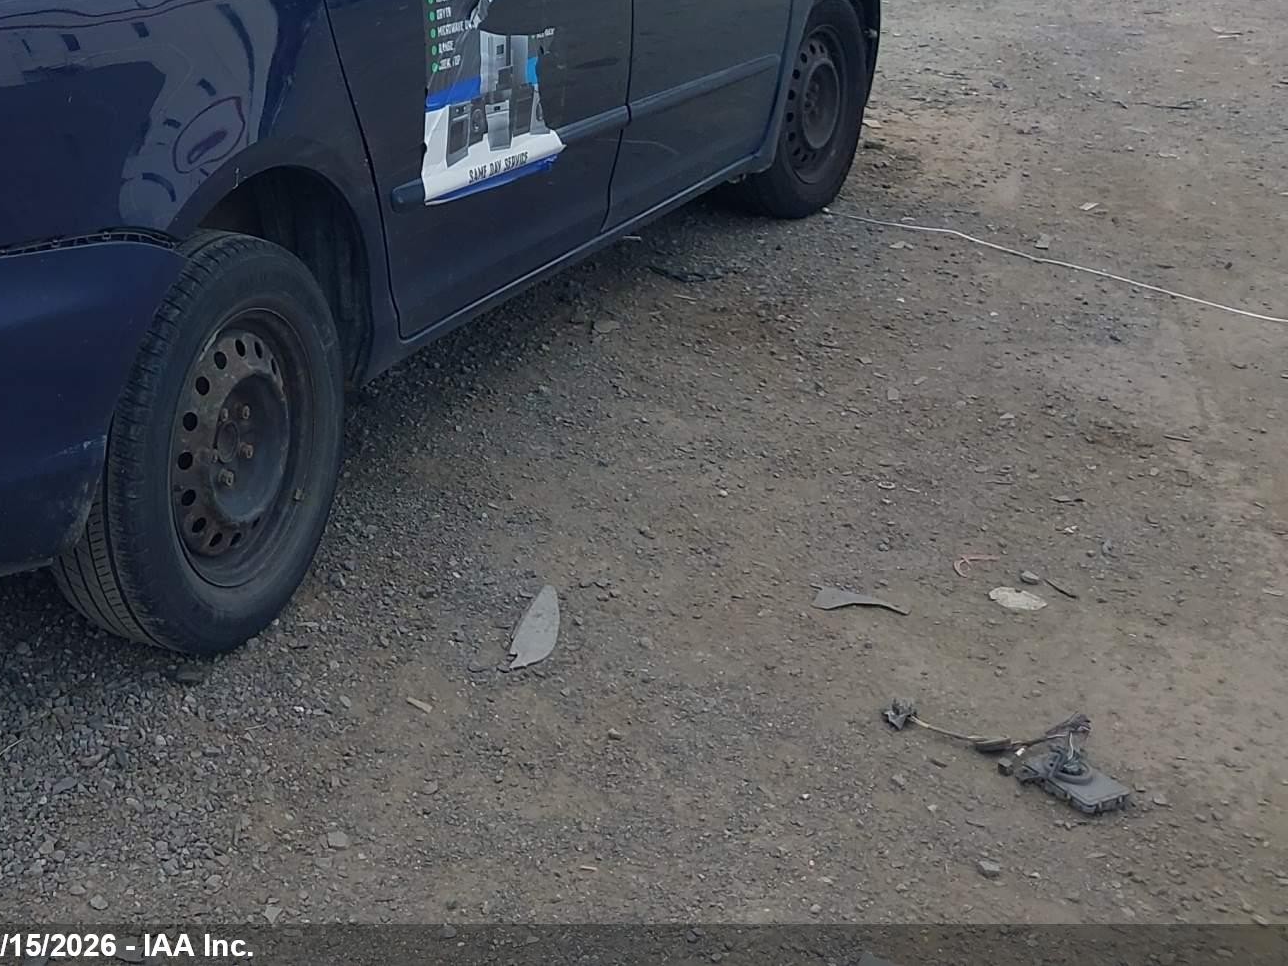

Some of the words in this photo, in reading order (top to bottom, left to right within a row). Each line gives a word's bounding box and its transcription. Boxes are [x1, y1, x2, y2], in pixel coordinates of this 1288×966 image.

[469, 164, 488, 184] SAME
[489, 159, 502, 176] DAY
[503, 151, 529, 172] SERVICE
